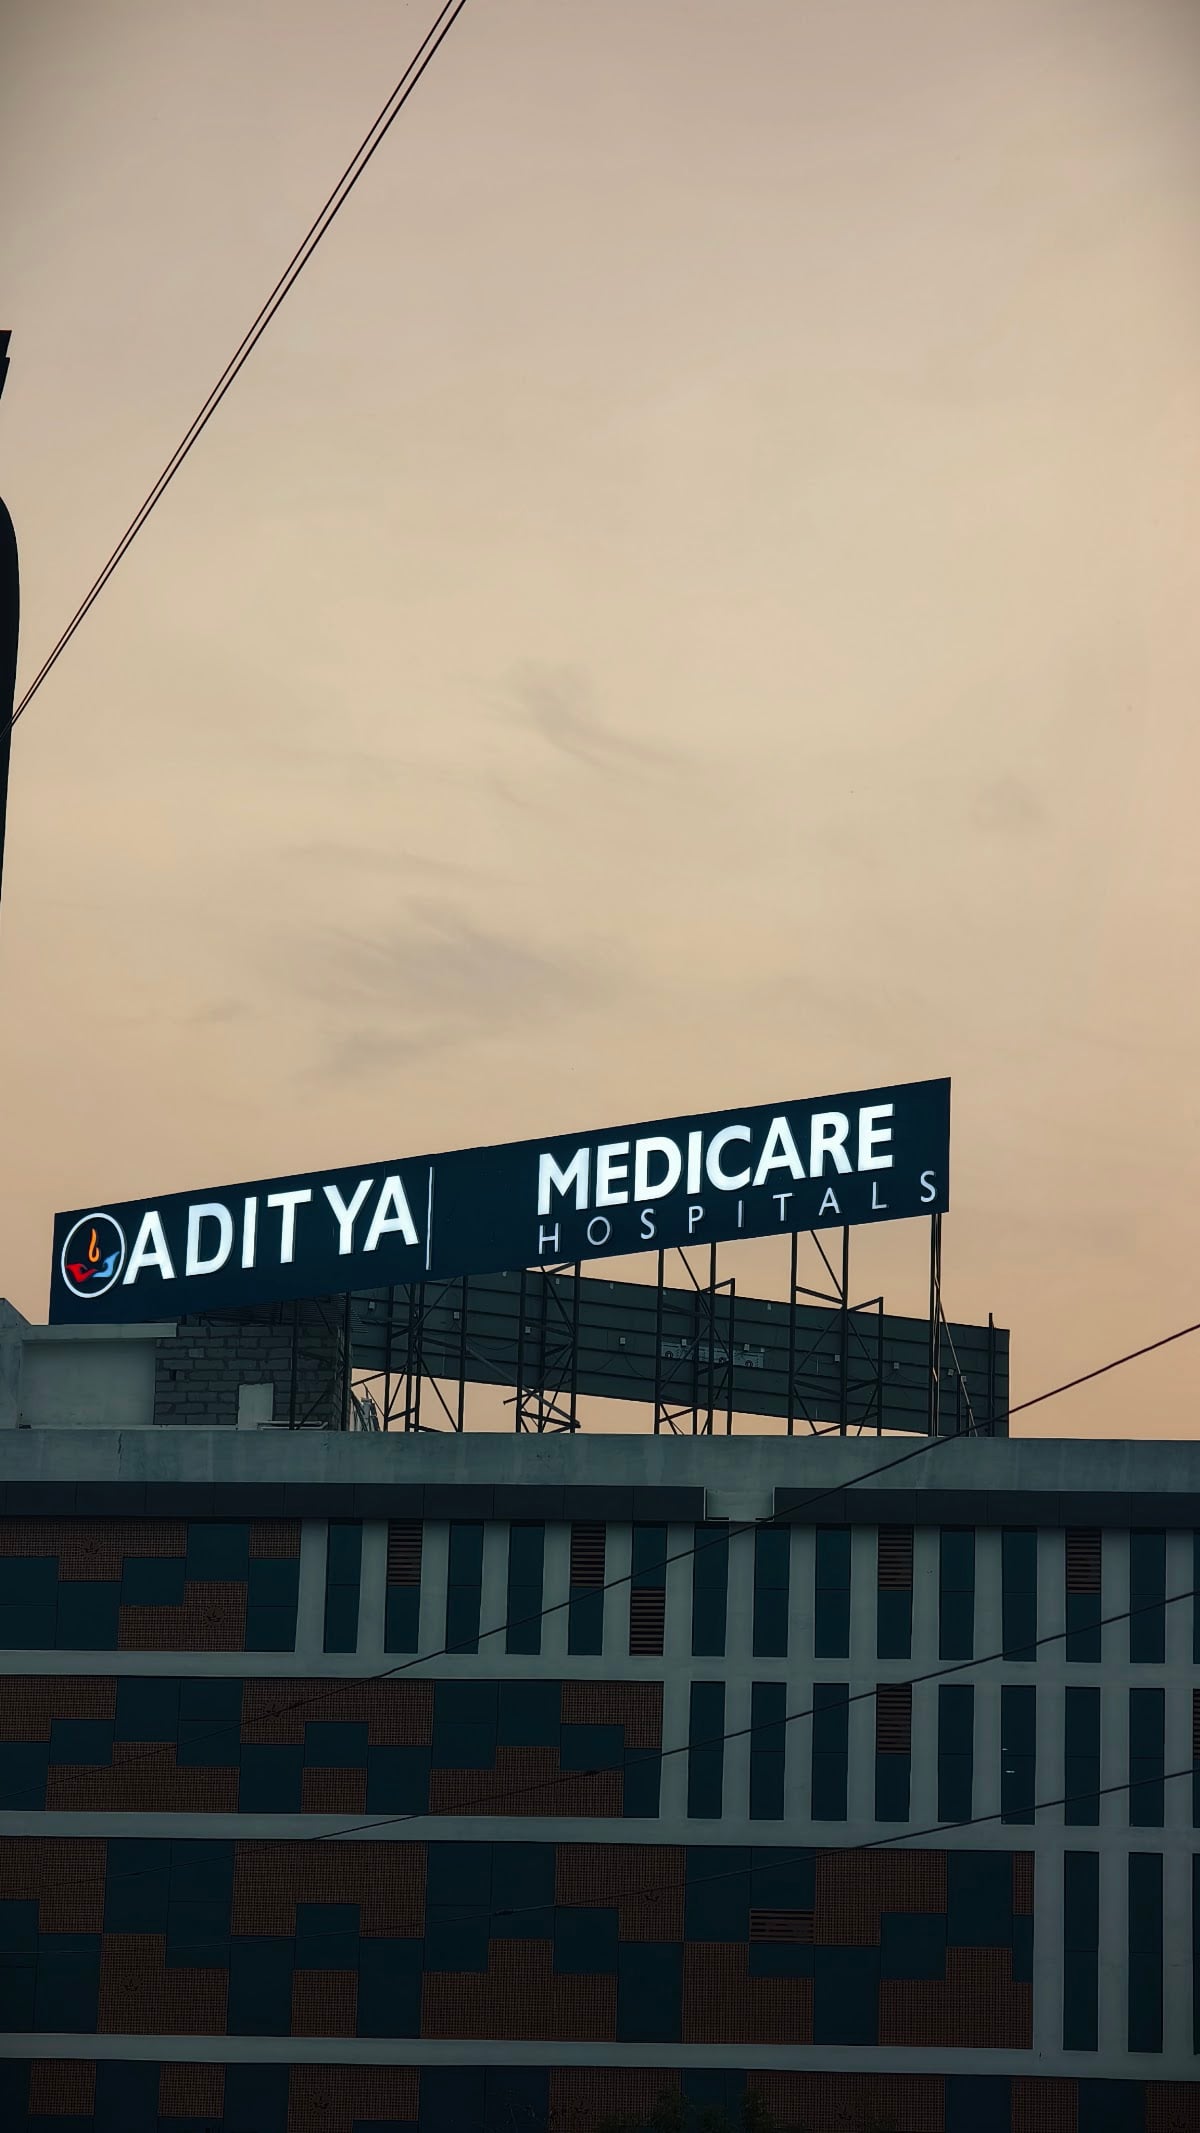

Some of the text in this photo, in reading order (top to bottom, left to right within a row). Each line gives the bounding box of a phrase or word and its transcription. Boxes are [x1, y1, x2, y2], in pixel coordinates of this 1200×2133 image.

[536, 1102, 895, 1216] MEDICARE
[537, 1169, 938, 1255] HOSPITALS
[121, 1174, 419, 1286] ADITYA
